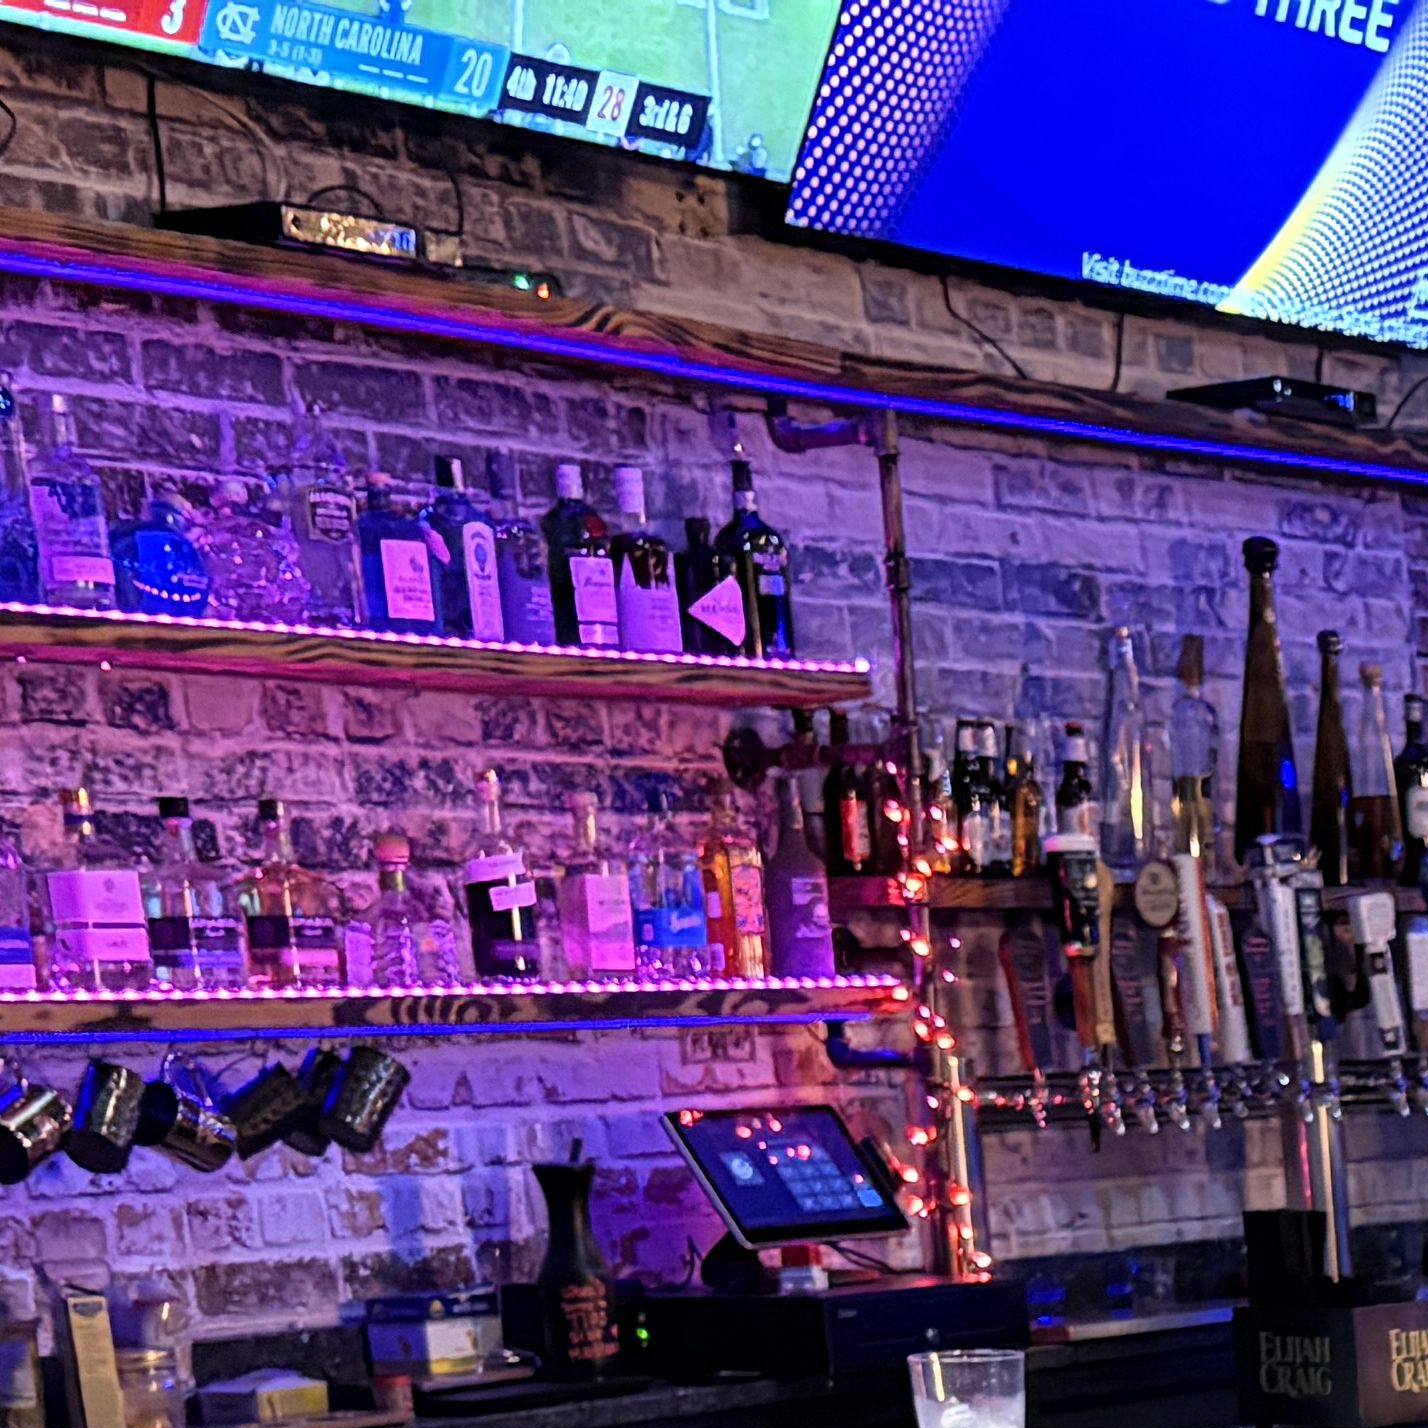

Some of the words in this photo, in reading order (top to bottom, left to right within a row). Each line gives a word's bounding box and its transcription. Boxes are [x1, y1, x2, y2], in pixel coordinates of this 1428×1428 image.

[270, 4, 335, 46] NORTH
[334, 18, 424, 66] CAROLINA
[1254, 0, 1399, 53] REE
[453, 48, 493, 98] 20
[597, 85, 626, 122] 28
[1259, 1331, 1330, 1364] ELIJAH
[1259, 1360, 1332, 1398] CRAIG
